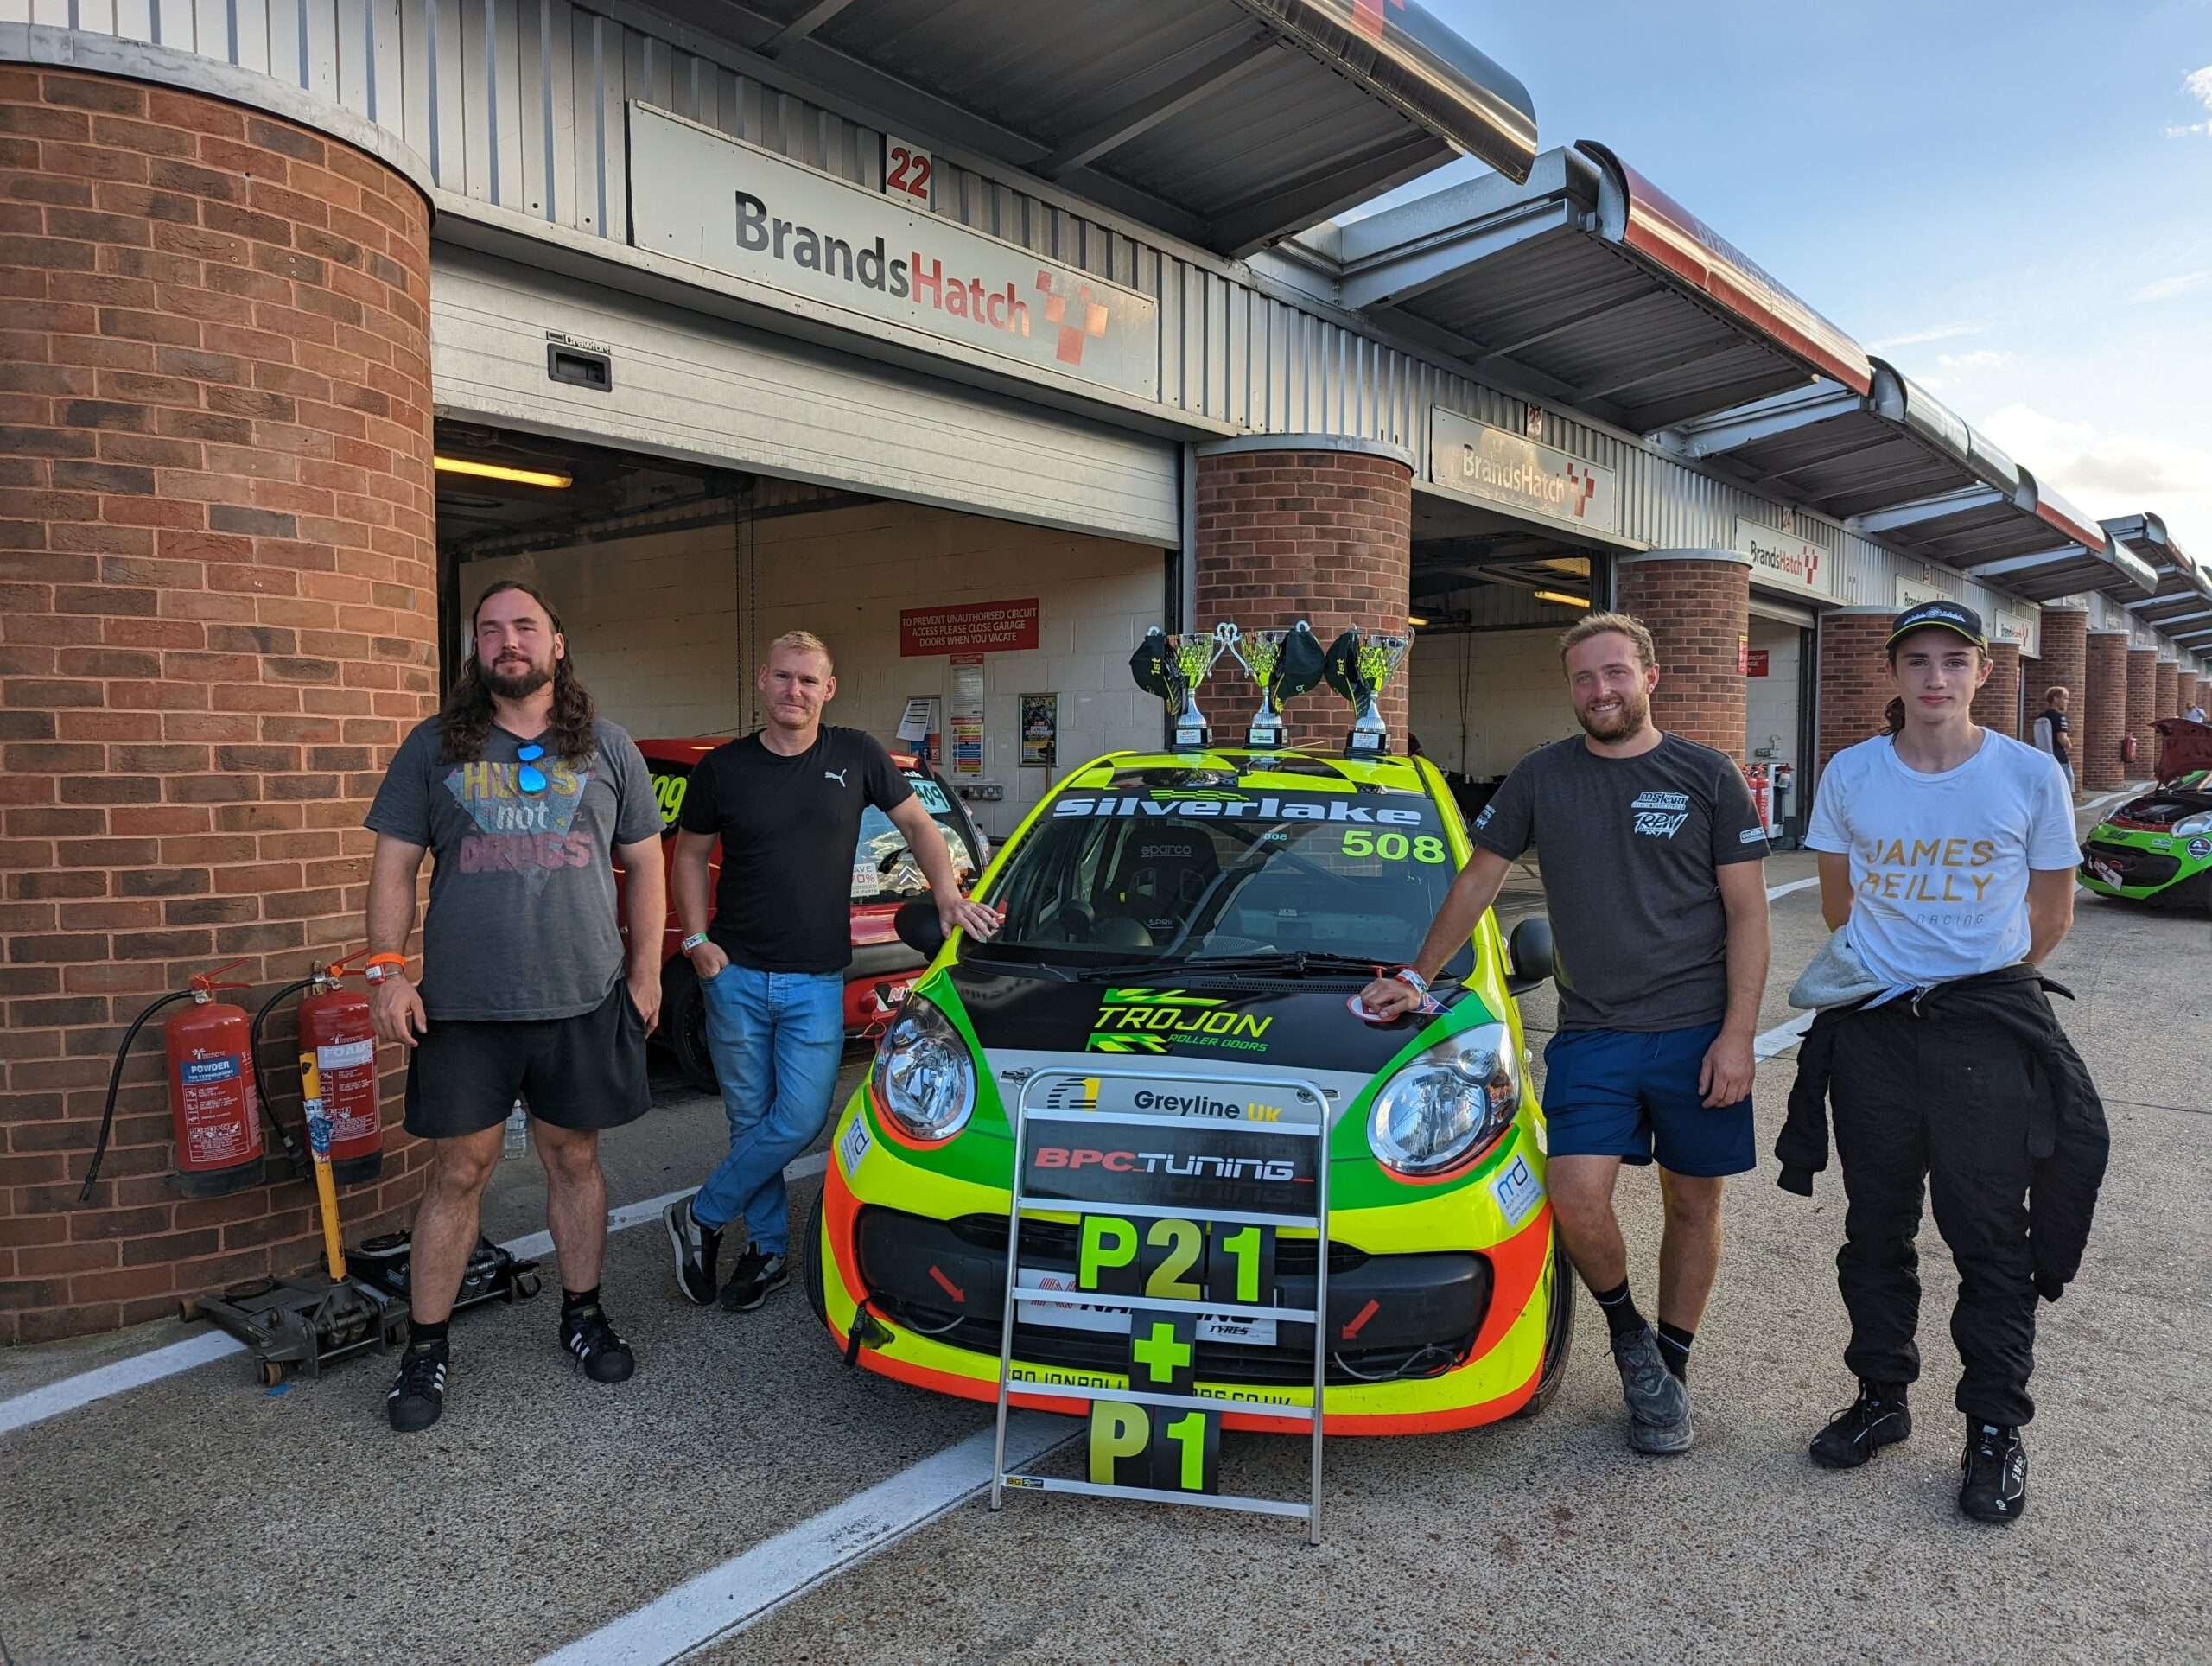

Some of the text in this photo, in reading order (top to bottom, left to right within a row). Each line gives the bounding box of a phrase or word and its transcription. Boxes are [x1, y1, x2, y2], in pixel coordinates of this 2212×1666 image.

[887, 146, 931, 200] 22
[735, 189, 1030, 340] BrandsHatch
[1463, 442, 1566, 505] BrandsHatch
[1751, 539, 1802, 577] BrandsHatch
[902, 607, 1037, 627] TO PREVENT UNAUTHORISED CIRCUIT
[912, 620, 1027, 637] ACCESS PLEASE CLOSE GARAGE
[919, 632, 1017, 648] DOORS WHEN YOU VACATE
[1150, 658, 1161, 676] 1st
[1337, 658, 1345, 676] 1st
[463, 760, 578, 802] HUS
[650, 774, 687, 823] 09
[1052, 796, 1421, 826] Silverlake
[496, 801, 550, 830] not
[1141, 844, 1192, 857] sparco
[1341, 830, 1446, 864] 508
[1866, 838, 1995, 866] JAMES
[1859, 871, 1994, 901] REILLY
[1094, 1007, 1274, 1038] TROJON
[1167, 1033, 1270, 1052] ROLLER DOORS
[191, 1060, 230, 1073] POWDER
[1134, 1090, 1284, 1122] Greyline UK
[1209, 1325, 1250, 1336] TYRES
[1090, 1400, 1207, 1491] P1
